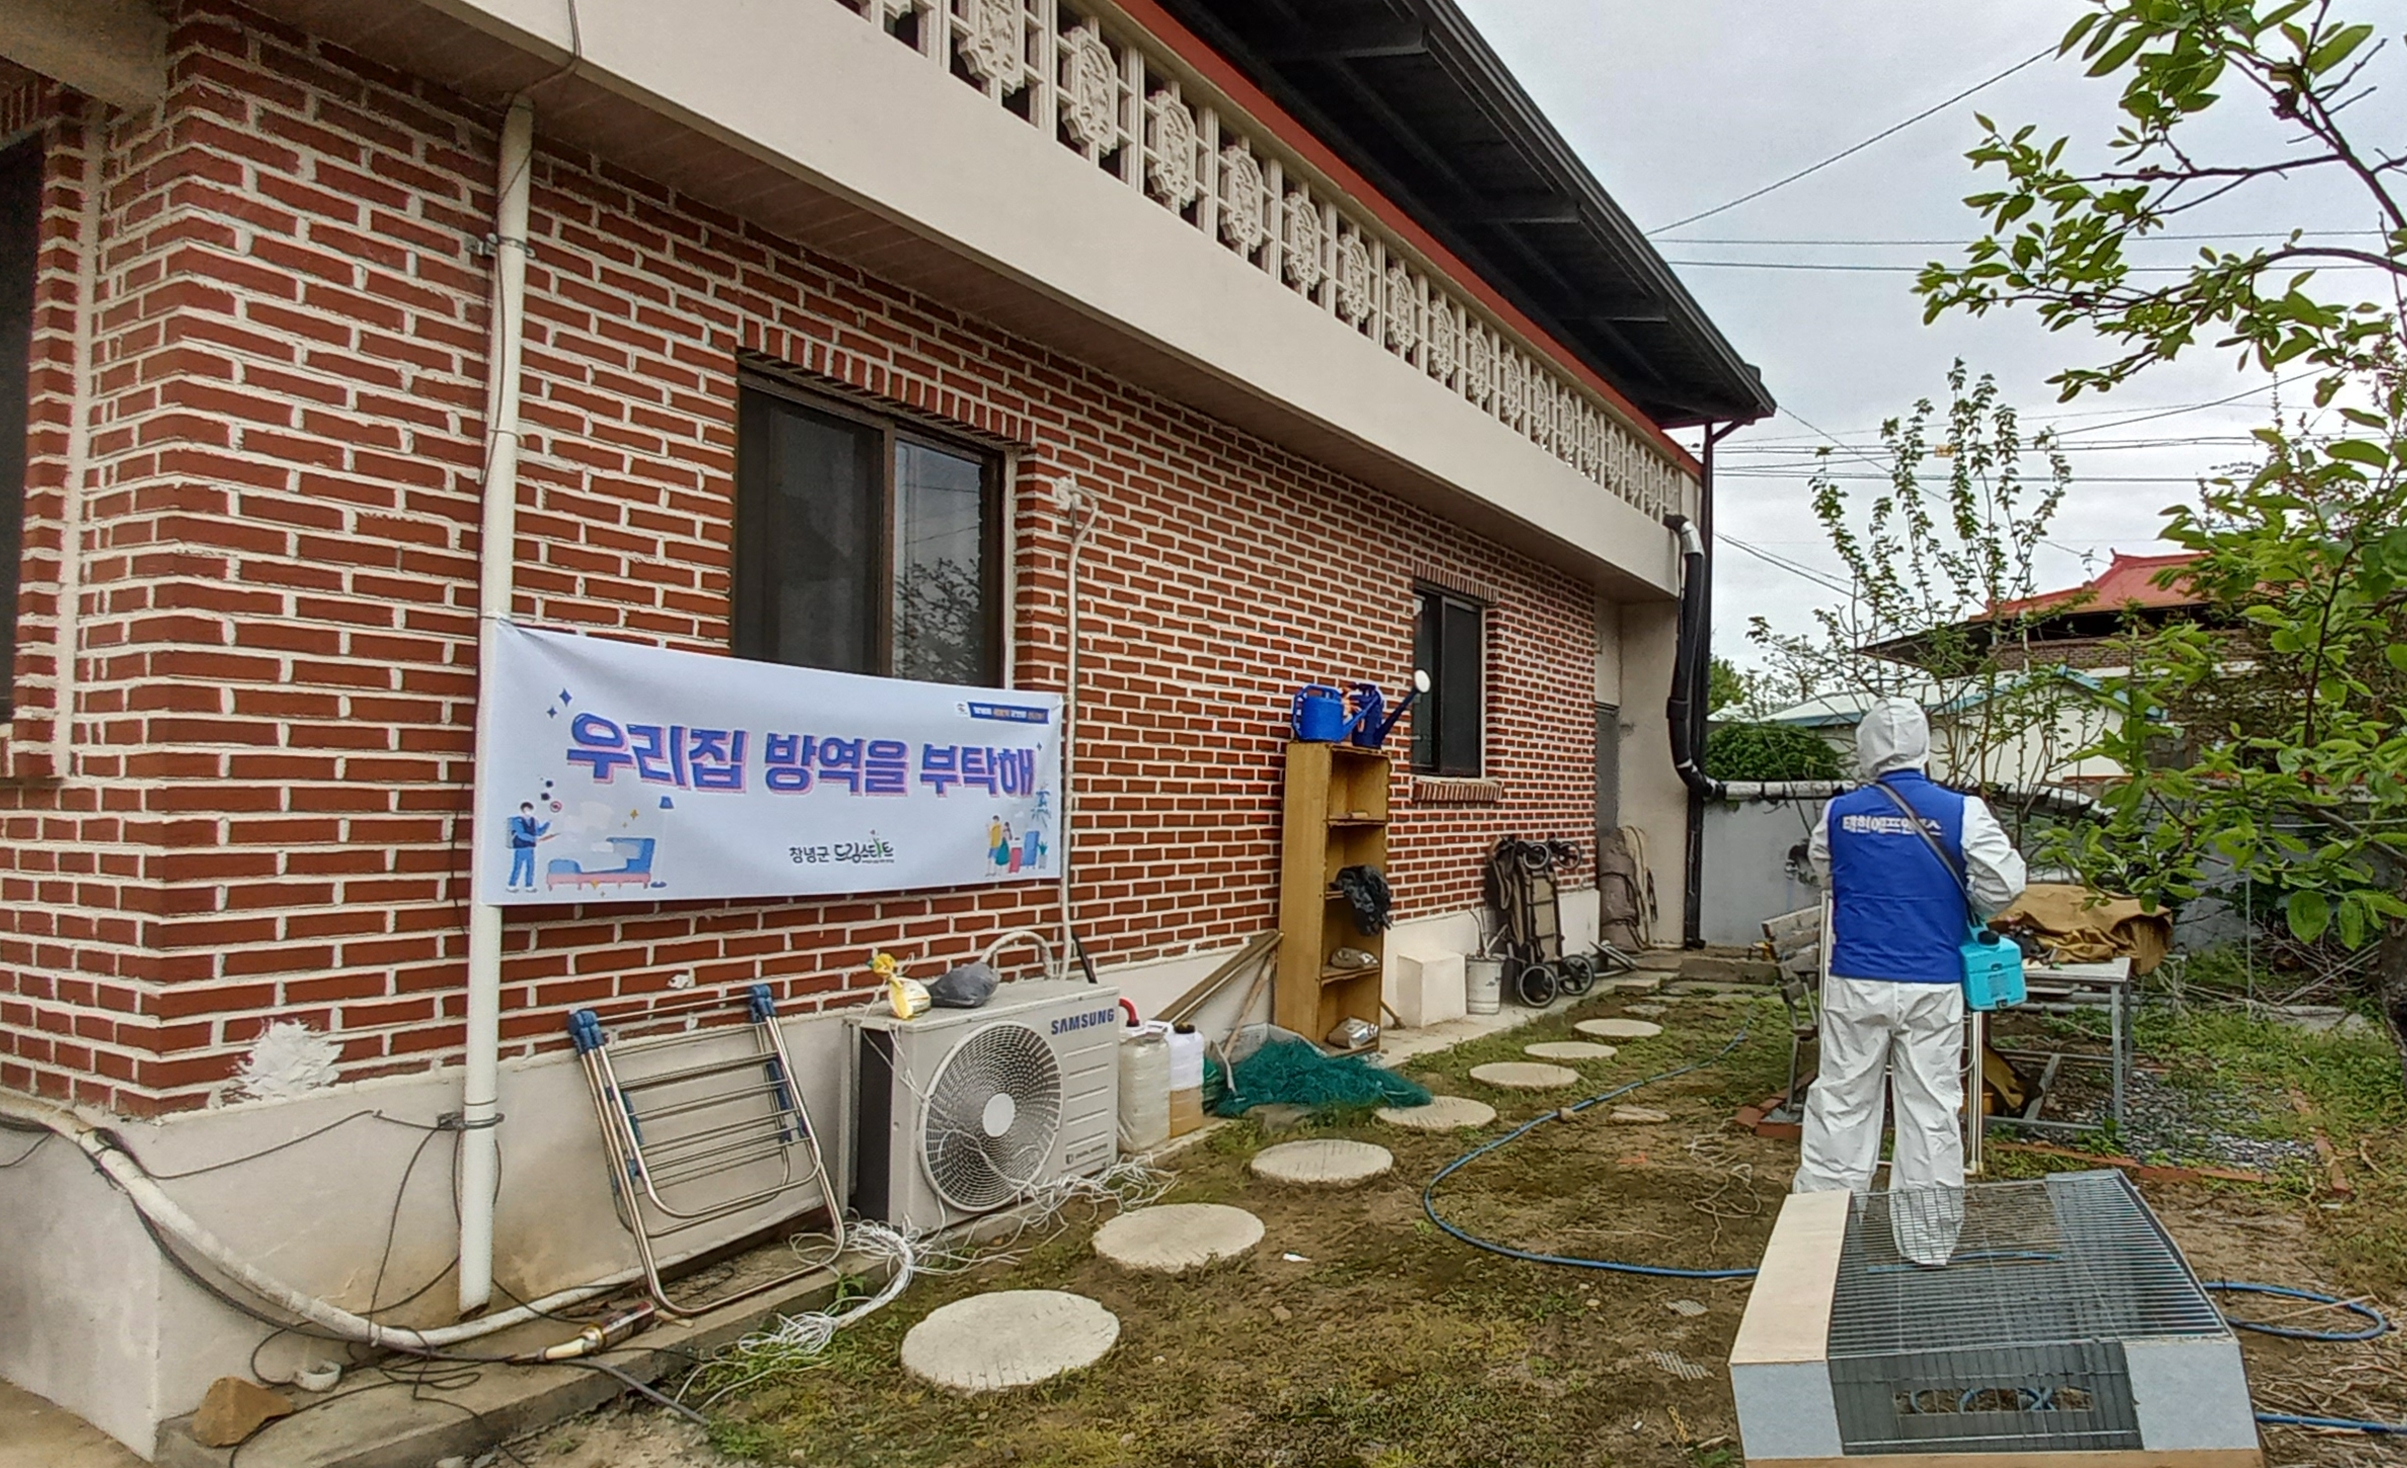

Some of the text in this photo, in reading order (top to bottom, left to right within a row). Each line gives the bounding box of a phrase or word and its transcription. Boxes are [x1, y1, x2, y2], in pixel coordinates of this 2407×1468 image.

[567, 712, 1036, 797] 우리집 방역을 부탁해
[789, 838, 894, 864] 창녕군 드림스타트
[1051, 1008, 1115, 1035] SAMSUNG
